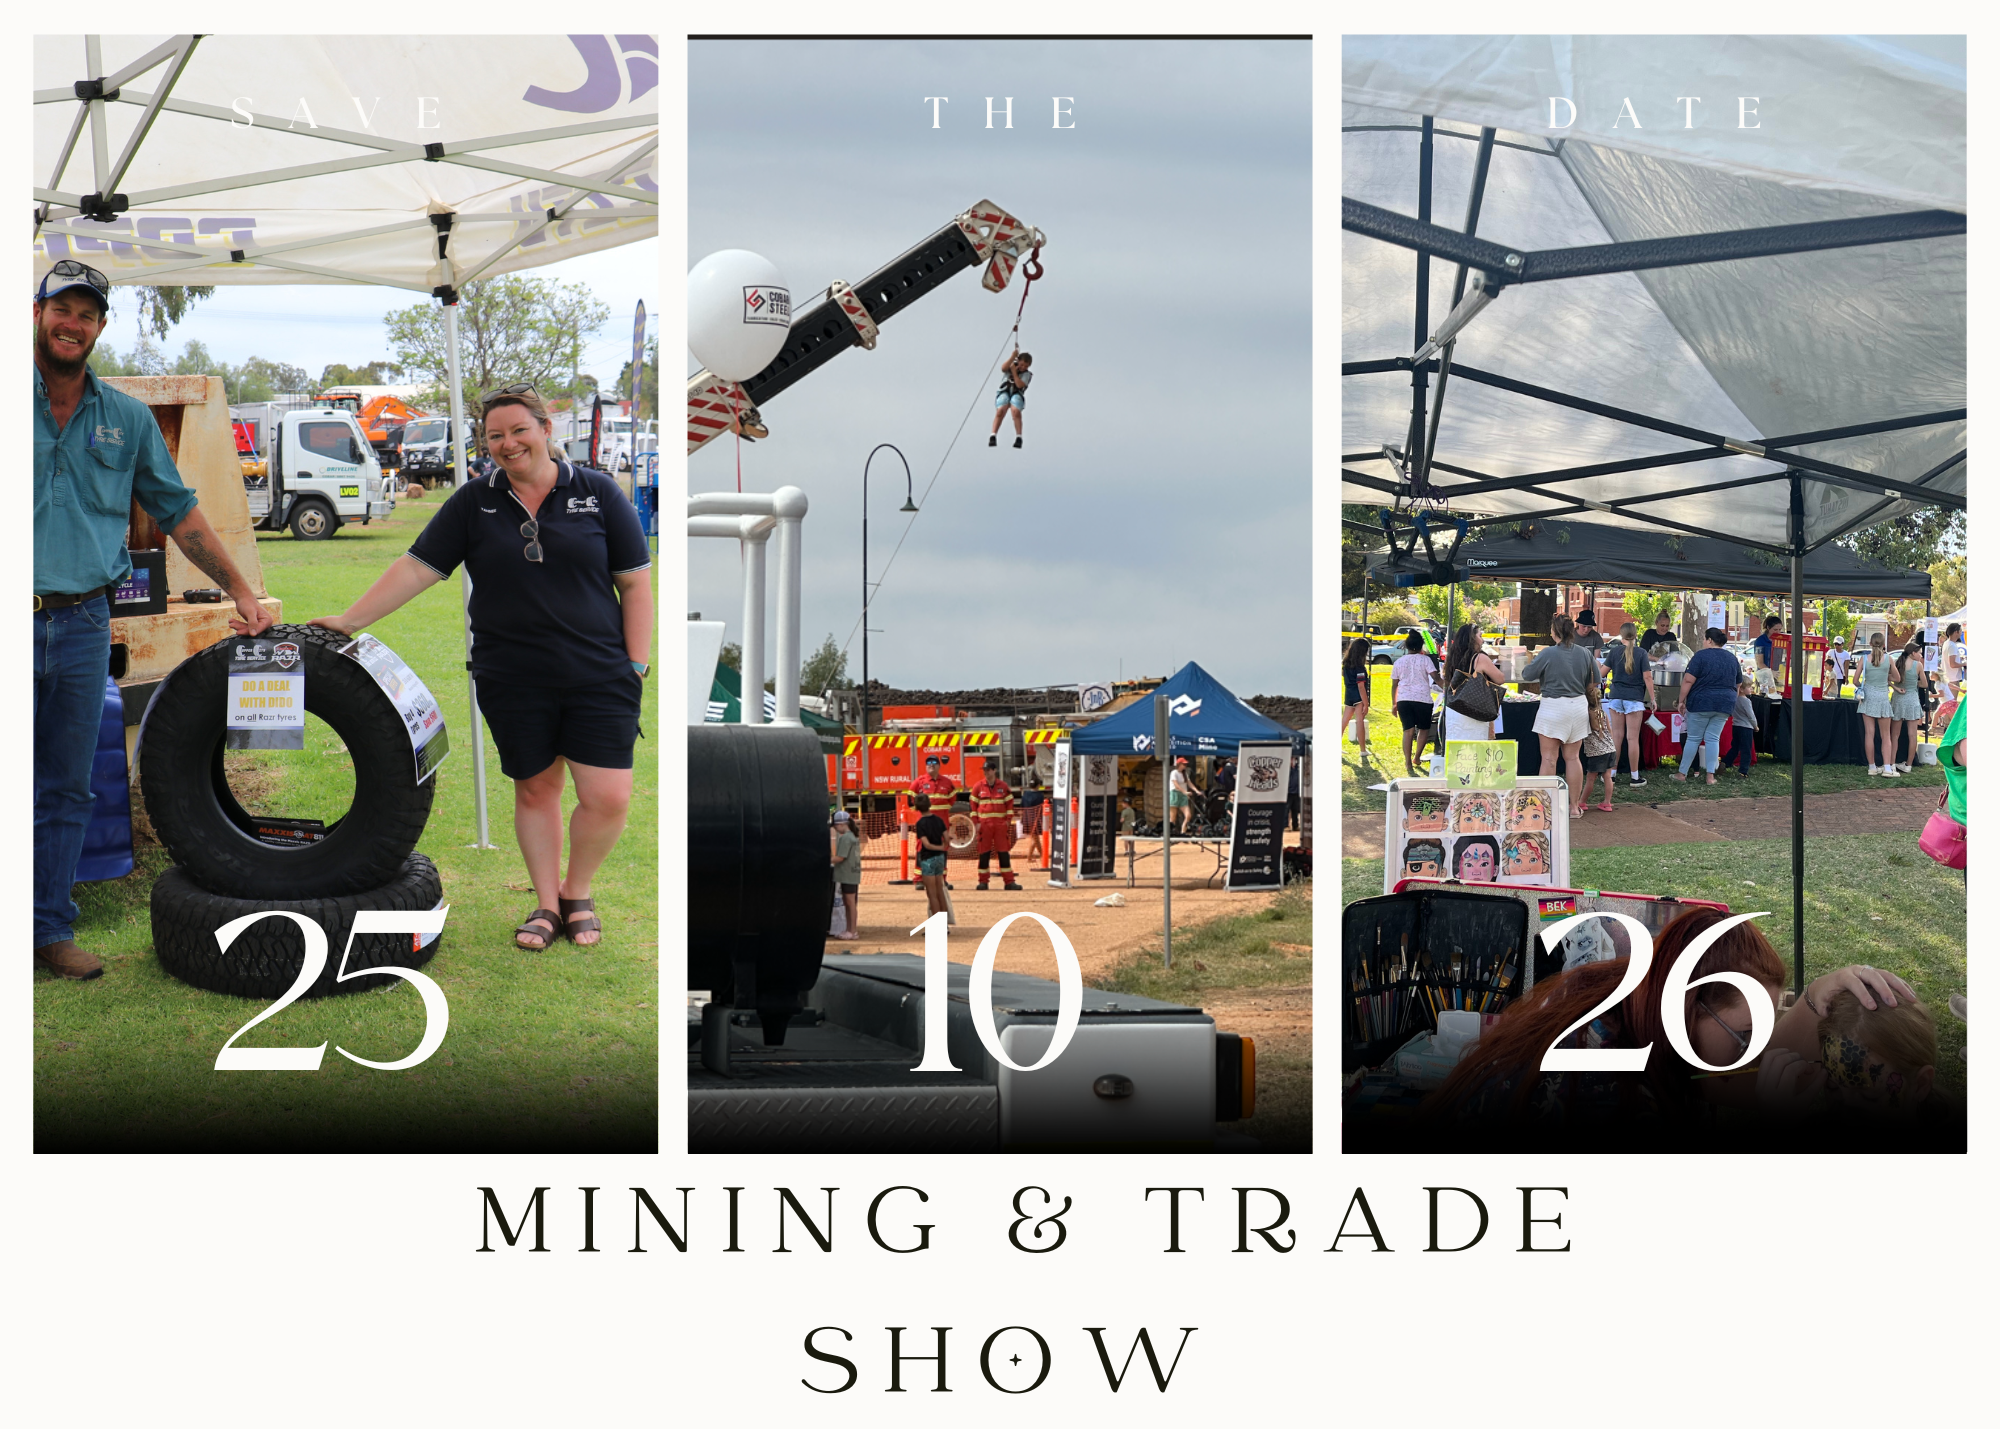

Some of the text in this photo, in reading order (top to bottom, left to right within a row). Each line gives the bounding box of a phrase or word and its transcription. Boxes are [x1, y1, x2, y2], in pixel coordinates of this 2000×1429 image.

[340, 487, 359, 496] LV02
[1467, 558, 1498, 567] Marquee
[242, 680, 290, 691] DO A DEAL
[239, 697, 293, 708] WITH DIDO
[277, 714, 296, 722] tyres
[1456, 747, 1504, 762] Face $10
[1247, 755, 1283, 768] Copper
[1455, 761, 1493, 778] Painting
[890, 775, 911, 783] RURAL
[1246, 778, 1279, 790] Heads
[1247, 809, 1273, 818] Courage
[259, 827, 294, 837] MAXXIS
[1245, 828, 1271, 837] strength
[1252, 837, 1271, 846] safety
[1546, 901, 1567, 912] BEK
